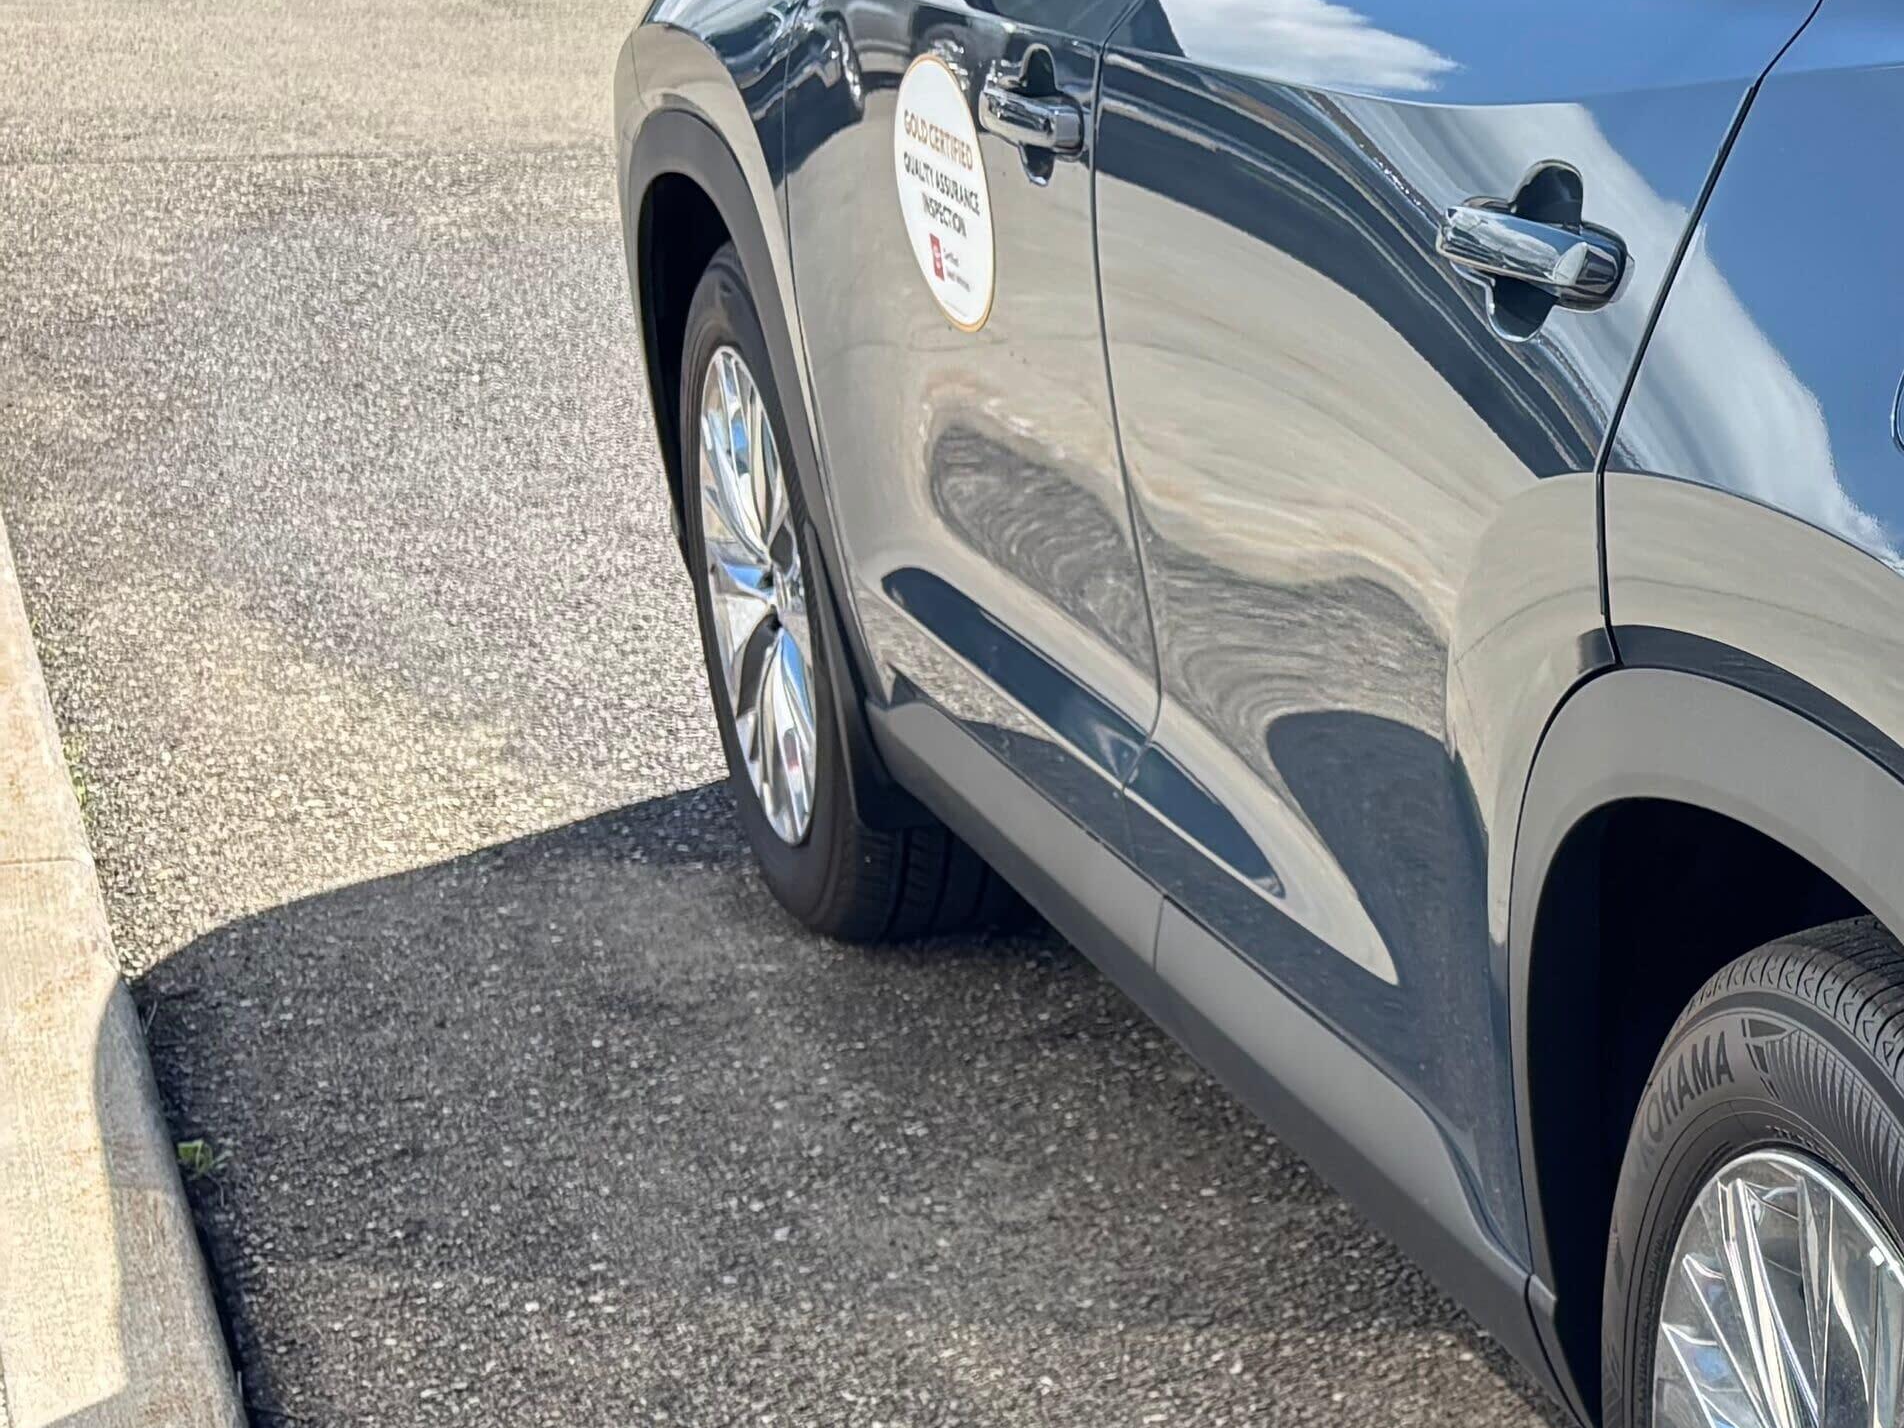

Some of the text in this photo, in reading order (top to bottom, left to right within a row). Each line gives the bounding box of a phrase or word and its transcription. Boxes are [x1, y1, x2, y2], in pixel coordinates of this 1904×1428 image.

[903, 109, 973, 171] GOLD CERTIFIED
[903, 151, 935, 189] QUALITY
